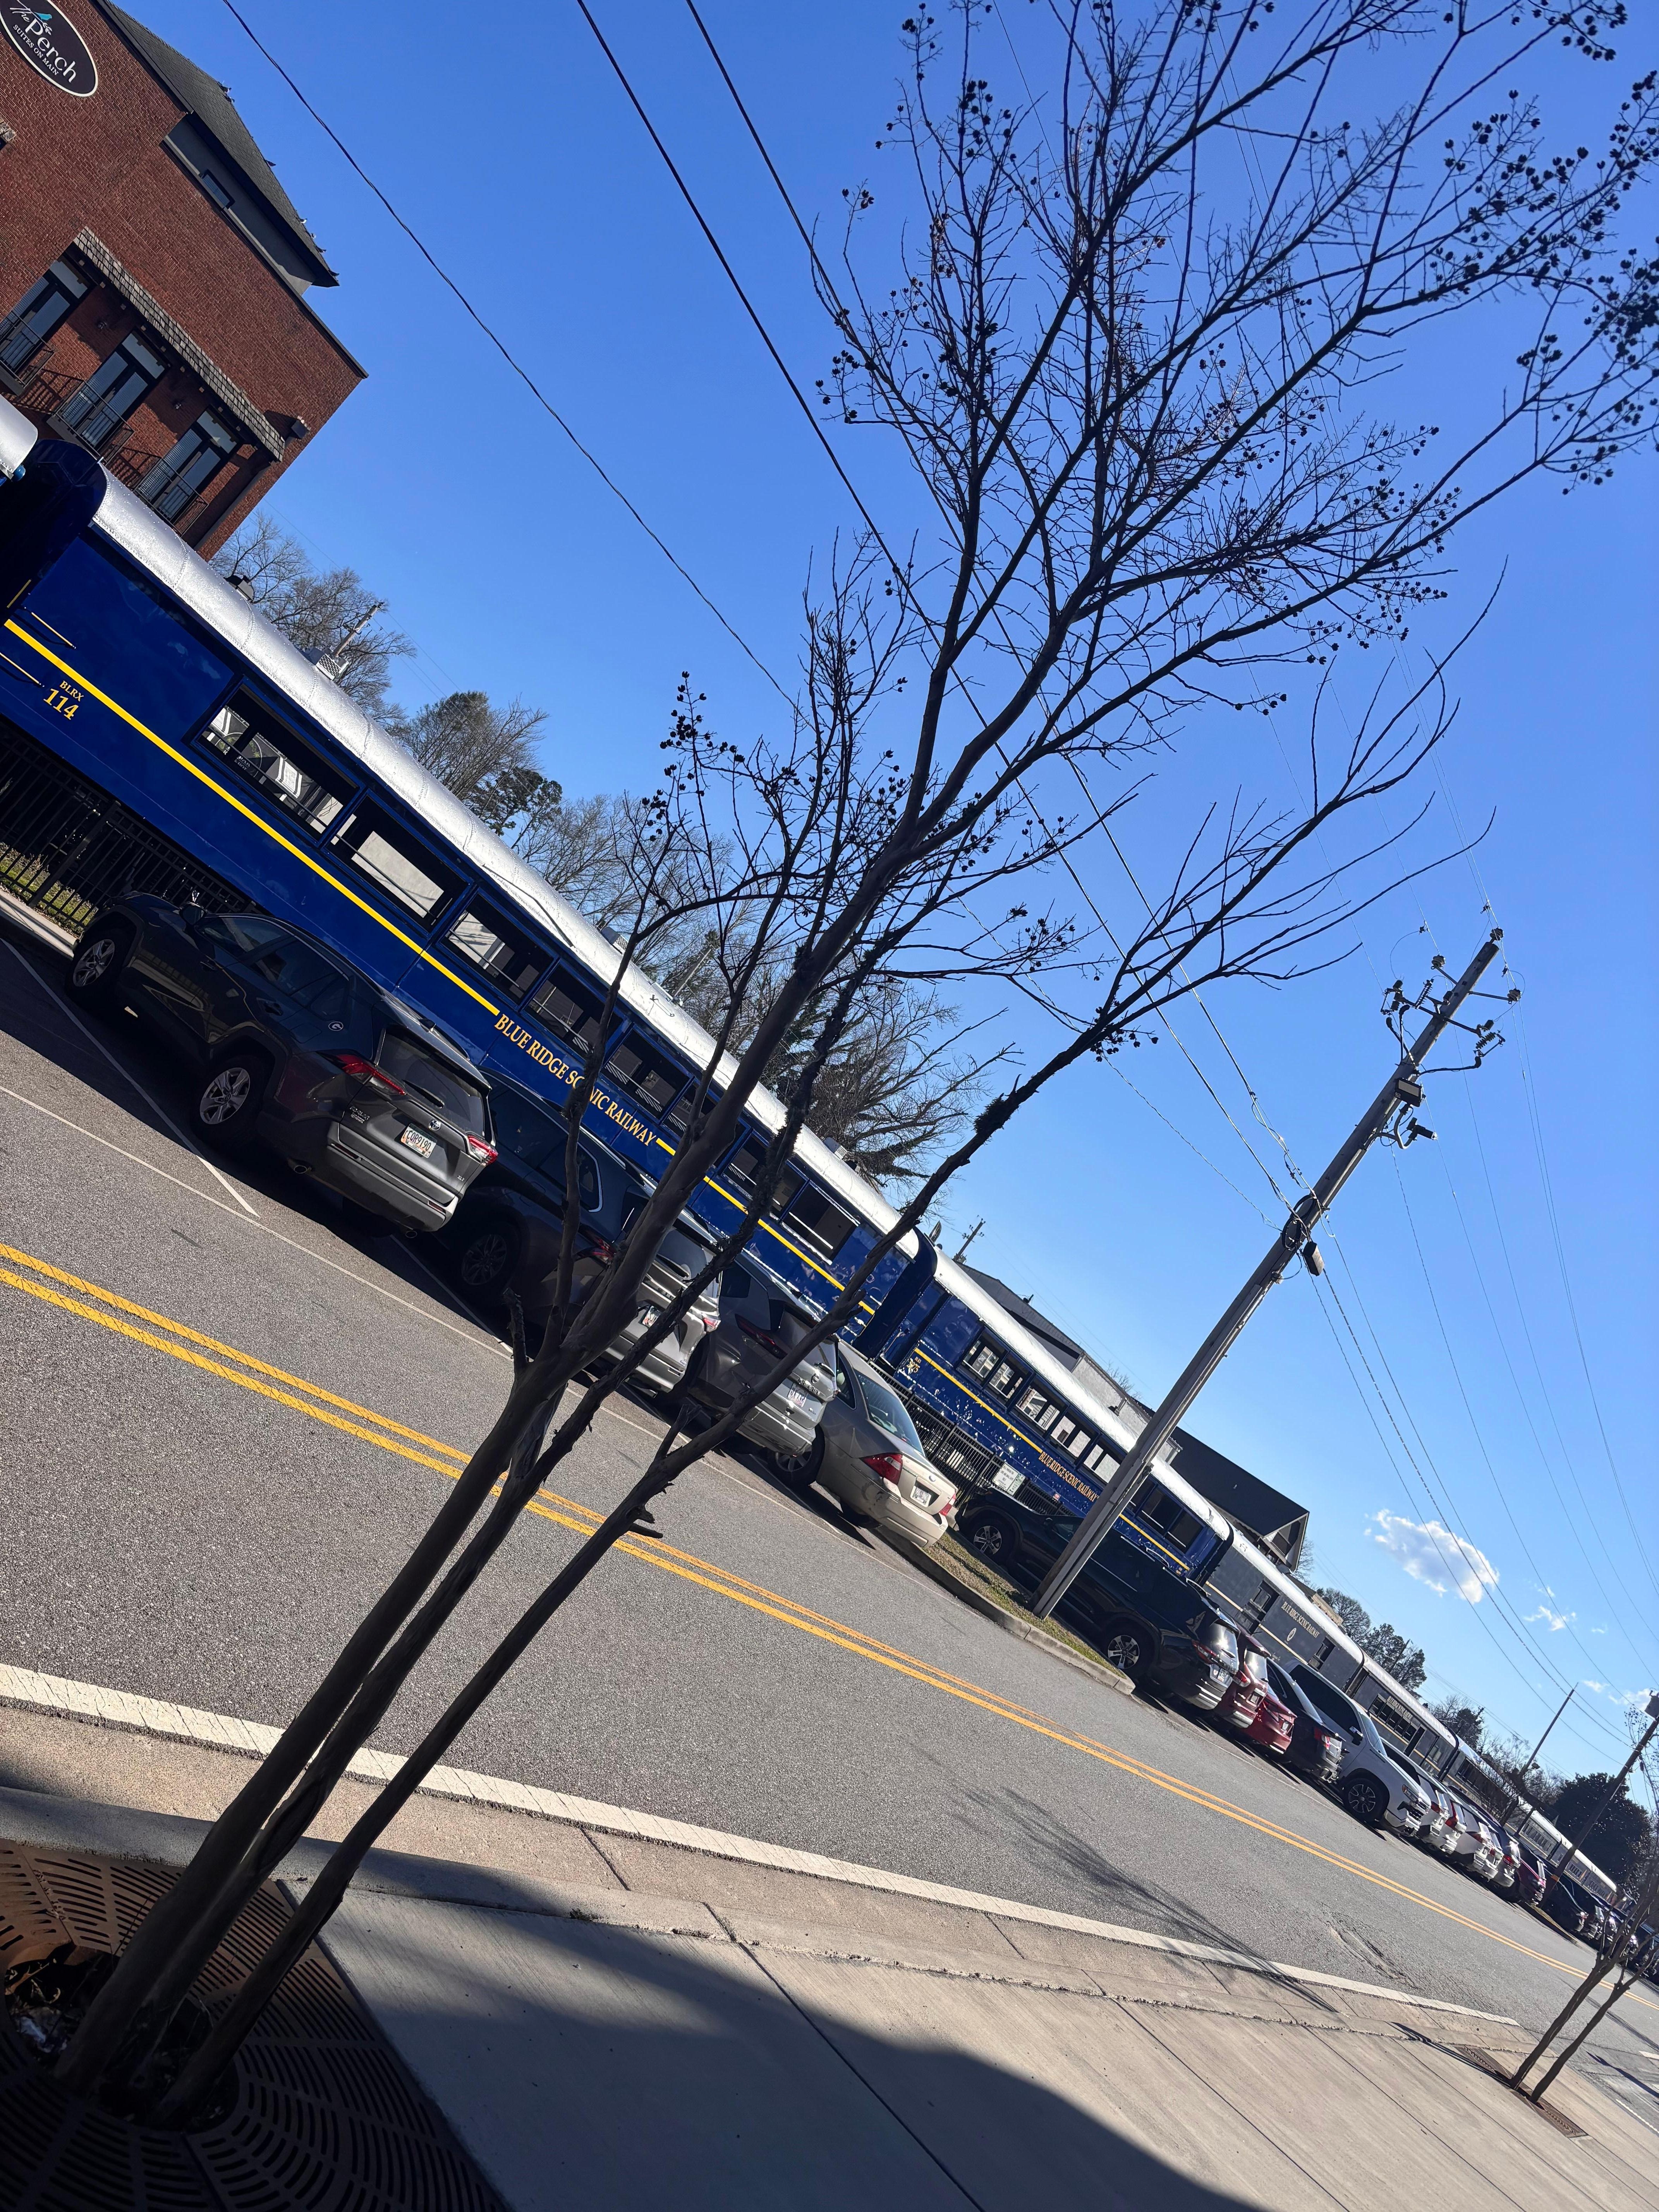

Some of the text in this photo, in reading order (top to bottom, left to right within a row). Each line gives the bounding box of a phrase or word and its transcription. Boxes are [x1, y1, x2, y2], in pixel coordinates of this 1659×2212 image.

[10, 8, 31, 22] The
[13, 24, 59, 75] SUITES ON MAIN
[25, 18, 76, 83] Perch
[43, 688, 79, 720] 114
[60, 680, 84, 701] BLRX
[494, 1014, 656, 1146] BLUE RIDGE SCNIC RAILWAY
[1039, 1451, 1099, 1502] BLUE RIDGE SCENIC RAILWAY
